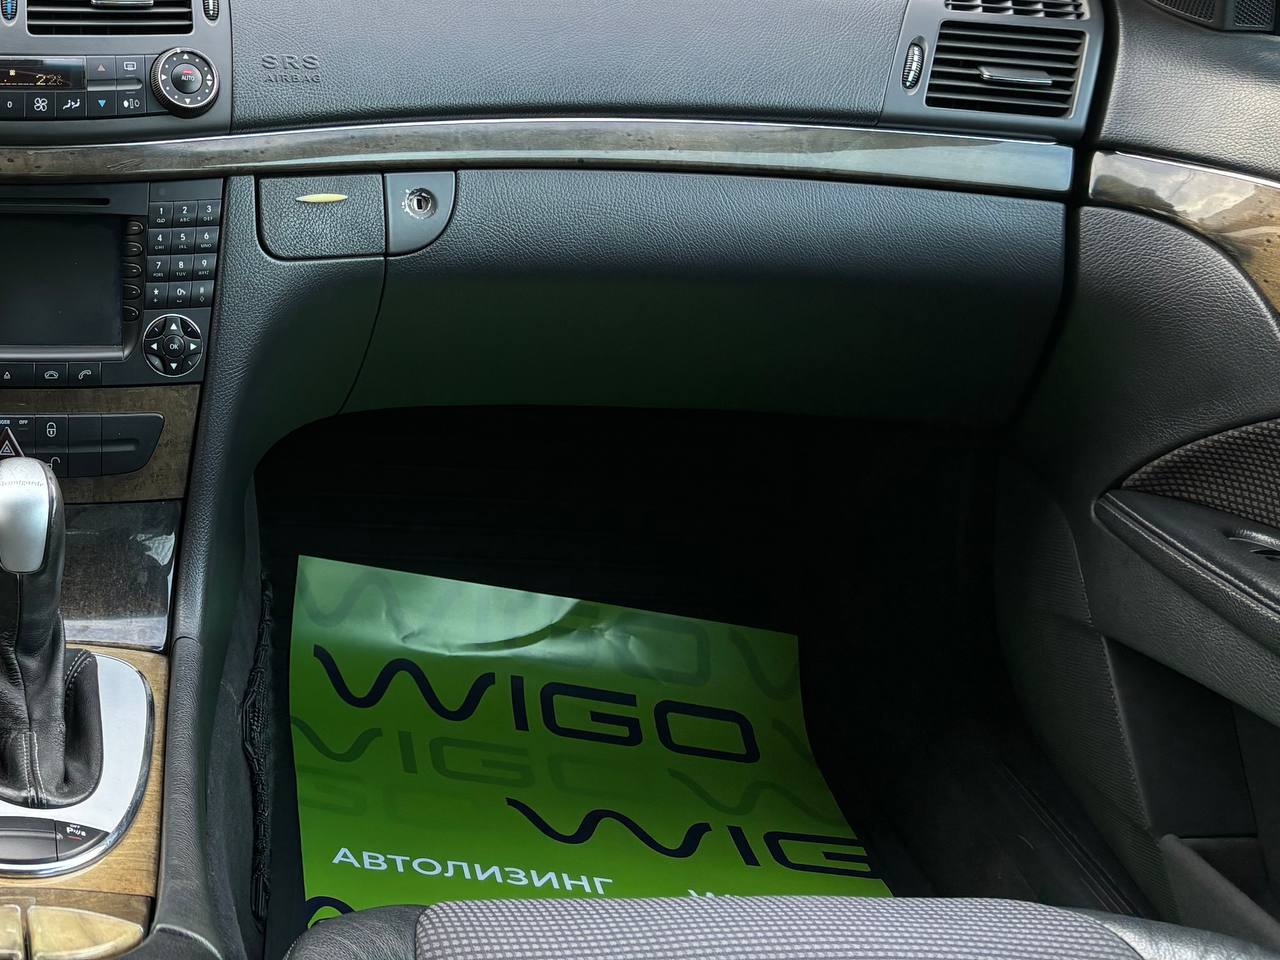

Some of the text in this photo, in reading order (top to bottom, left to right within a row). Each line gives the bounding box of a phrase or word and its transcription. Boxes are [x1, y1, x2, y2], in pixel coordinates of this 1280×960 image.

[261, 54, 319, 70] SRS
[265, 74, 321, 83] AIRBAG
[313, 644, 760, 763] WIGO
[332, 847, 613, 895] АВТОЛИЗИНГ
